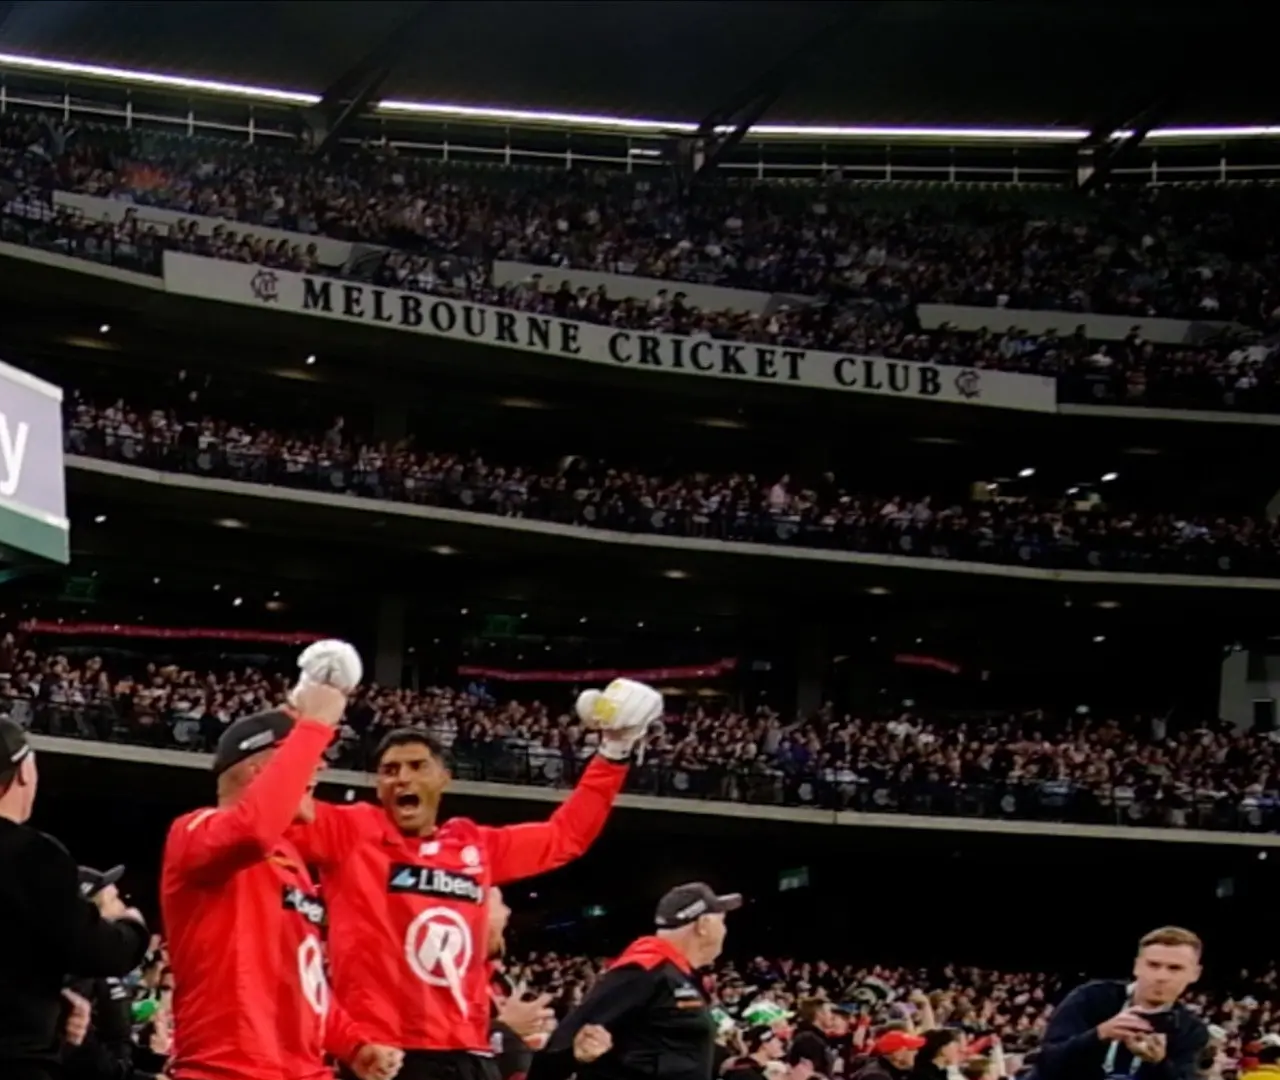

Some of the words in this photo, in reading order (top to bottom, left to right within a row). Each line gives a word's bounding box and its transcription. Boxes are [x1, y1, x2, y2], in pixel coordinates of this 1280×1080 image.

[301, 277, 582, 354] MELBOURNE
[608, 331, 806, 381] CRICKET
[833, 357, 942, 396] CLUB
